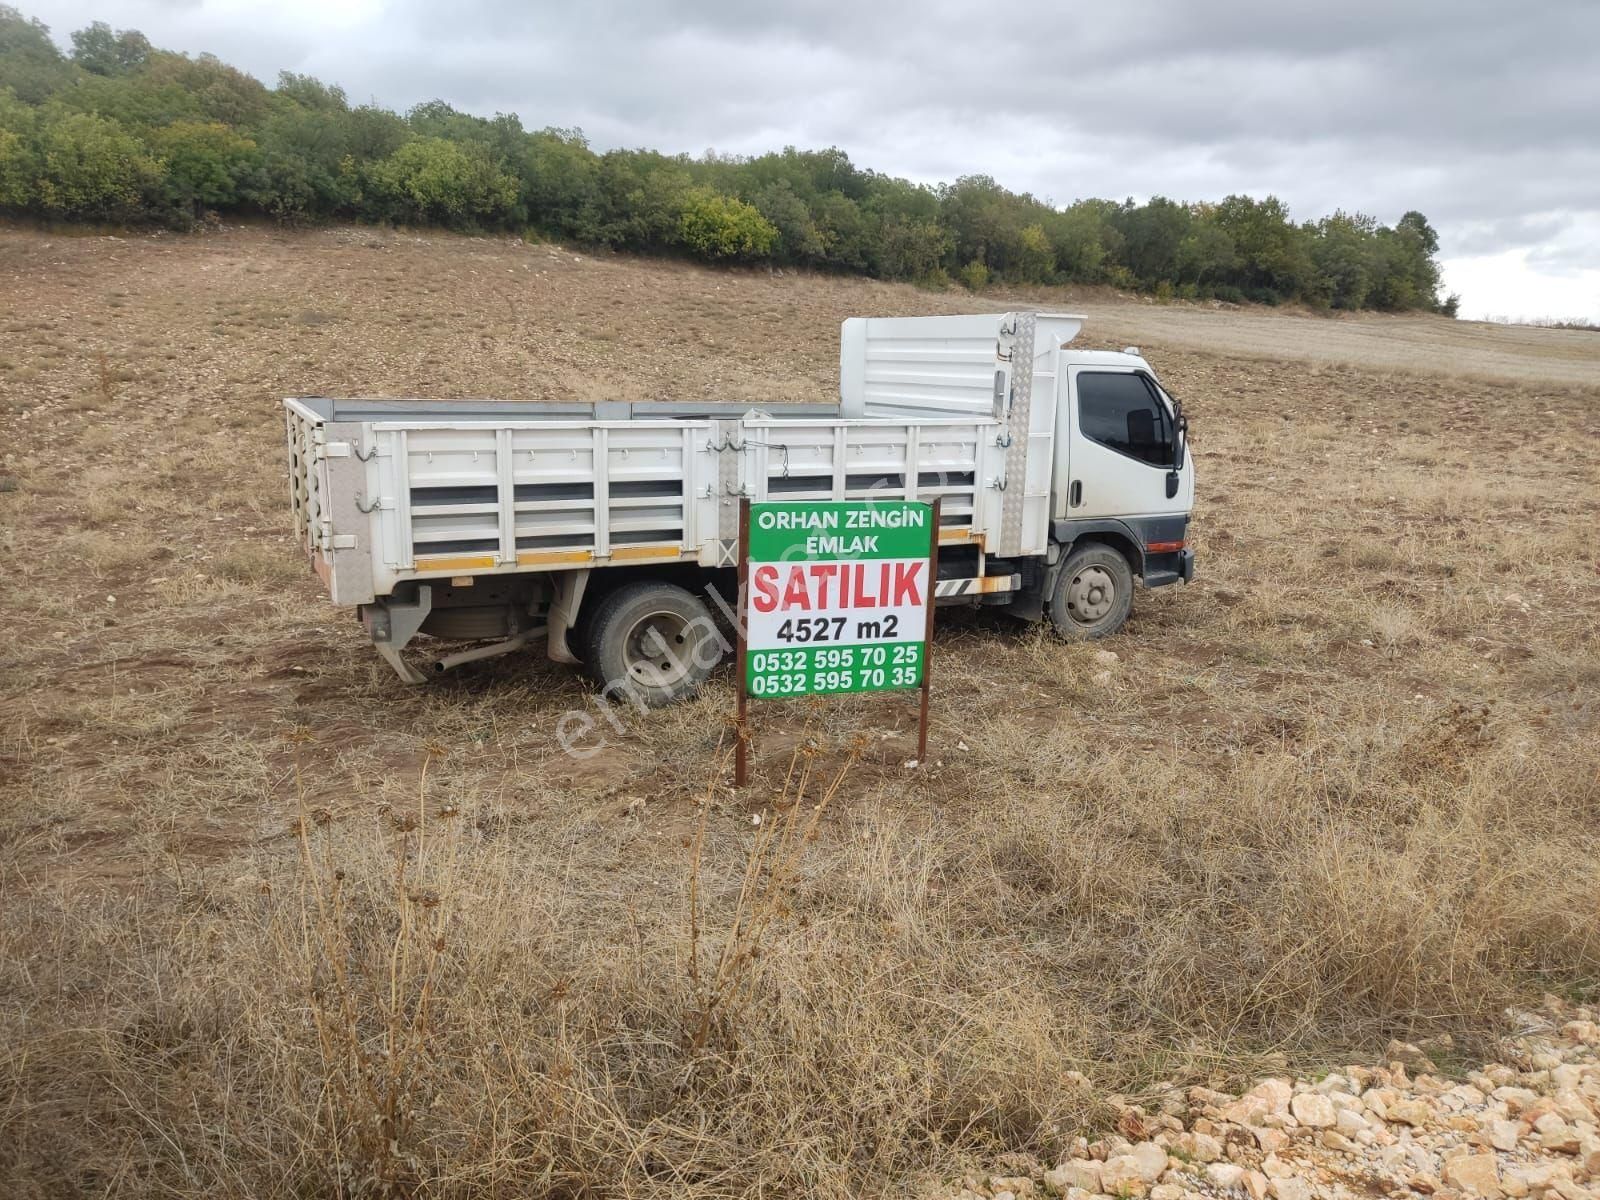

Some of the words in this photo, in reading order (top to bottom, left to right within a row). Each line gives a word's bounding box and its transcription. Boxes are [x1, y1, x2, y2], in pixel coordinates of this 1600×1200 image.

[758, 511, 838, 530] ORHAN
[845, 506, 924, 528] ZENGİN
[806, 535, 879, 554] EMLAK
[753, 562, 924, 613] SATILIK
[777, 617, 847, 643] 4527
[857, 615, 898, 639] m2
[753, 652, 807, 673] 0532
[814, 649, 853, 669] 595
[860, 647, 886, 666] 70
[892, 646, 918, 664] 25
[752, 674, 807, 695] 0532
[814, 671, 853, 691] 595
[860, 669, 885, 687] 70
[891, 667, 917, 685] 35
